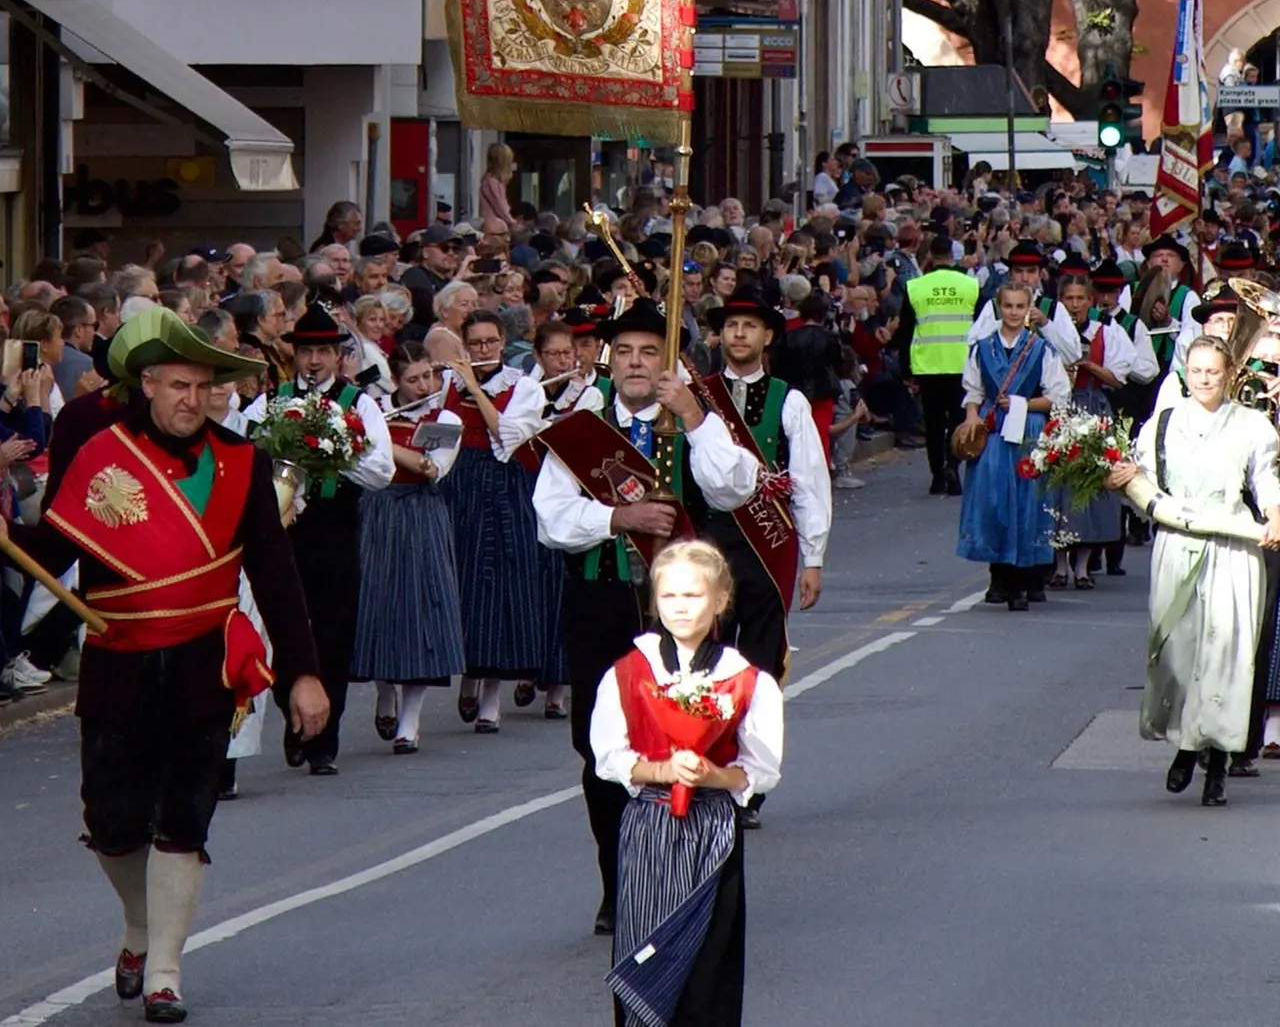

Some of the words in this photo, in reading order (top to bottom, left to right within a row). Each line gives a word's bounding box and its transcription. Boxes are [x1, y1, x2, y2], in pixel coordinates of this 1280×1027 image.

[932, 287, 957, 297] STS
[927, 297, 964, 306] SECURITY
[747, 494, 784, 549] ERAN
